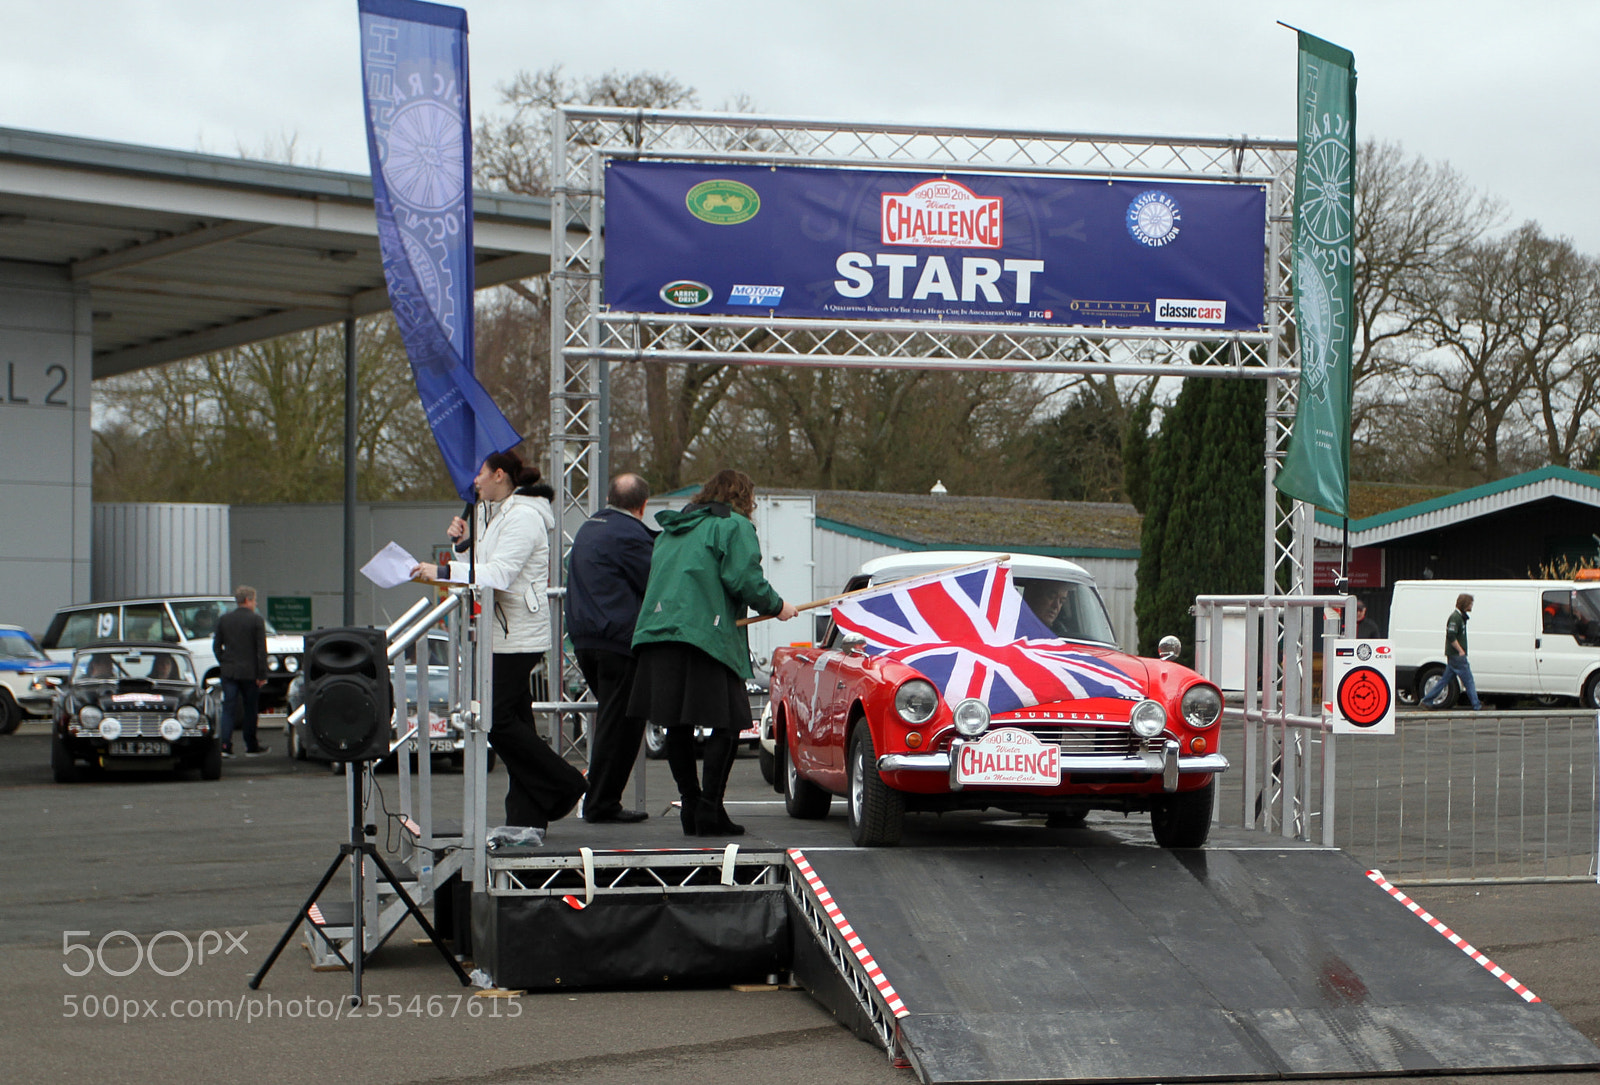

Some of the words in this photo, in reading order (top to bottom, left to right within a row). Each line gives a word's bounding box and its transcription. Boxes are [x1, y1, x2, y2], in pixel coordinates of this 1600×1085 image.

[925, 200, 956, 209] Winter
[1130, 193, 1156, 221] CLASSIC
[1159, 195, 1181, 221] RALLY
[886, 198, 999, 246] CHALLENGE
[1131, 225, 1180, 247] ASSOCIATION
[834, 251, 1045, 304] START
[734, 286, 781, 296] MOTORS
[749, 296, 764, 304] TV
[0, 362, 29, 404] L
[45, 363, 68, 405] 2
[97, 613, 114, 638] 19
[1014, 712, 1104, 720] SUNBEAM
[1006, 733, 1012, 742] 3
[961, 746, 1057, 778] CHALLENGE
